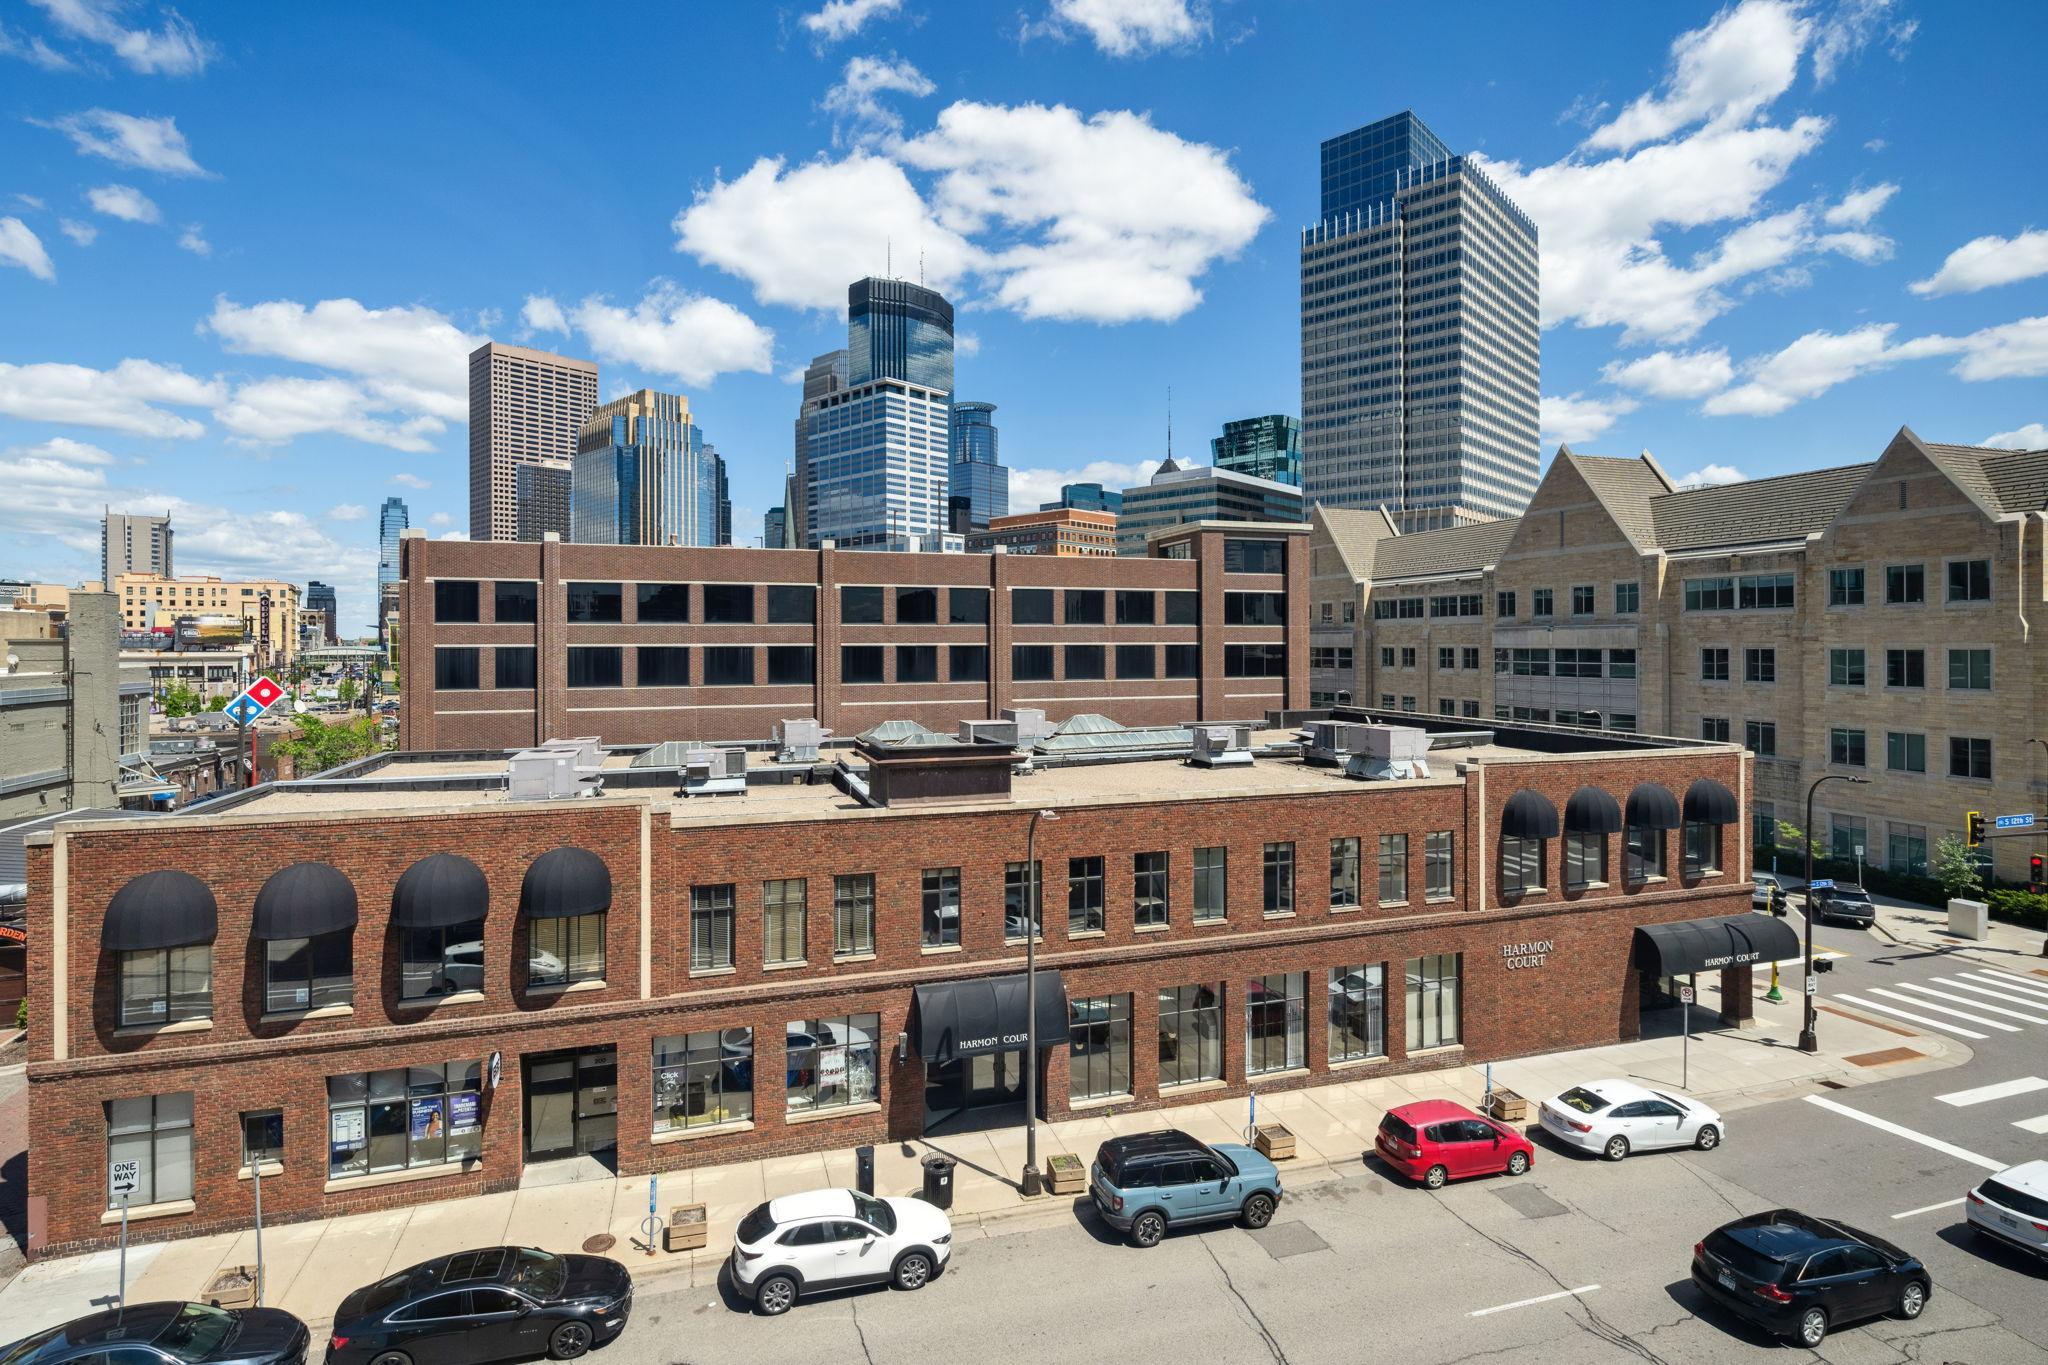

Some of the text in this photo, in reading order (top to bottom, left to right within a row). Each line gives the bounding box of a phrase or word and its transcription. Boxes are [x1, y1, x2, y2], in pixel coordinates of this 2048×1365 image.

[261, 600, 269, 641] ORPHEUM
[2011, 817, 2024, 825] 12th
[1503, 940, 1553, 957] HARMON
[1507, 954, 1546, 969] COURT
[1705, 952, 1760, 967] HARMON COURT
[960, 1033, 1029, 1049] HARMON COUR
[661, 1072, 679, 1080] Click
[114, 1162, 136, 1172] ONE
[114, 1171, 136, 1181] WAY
